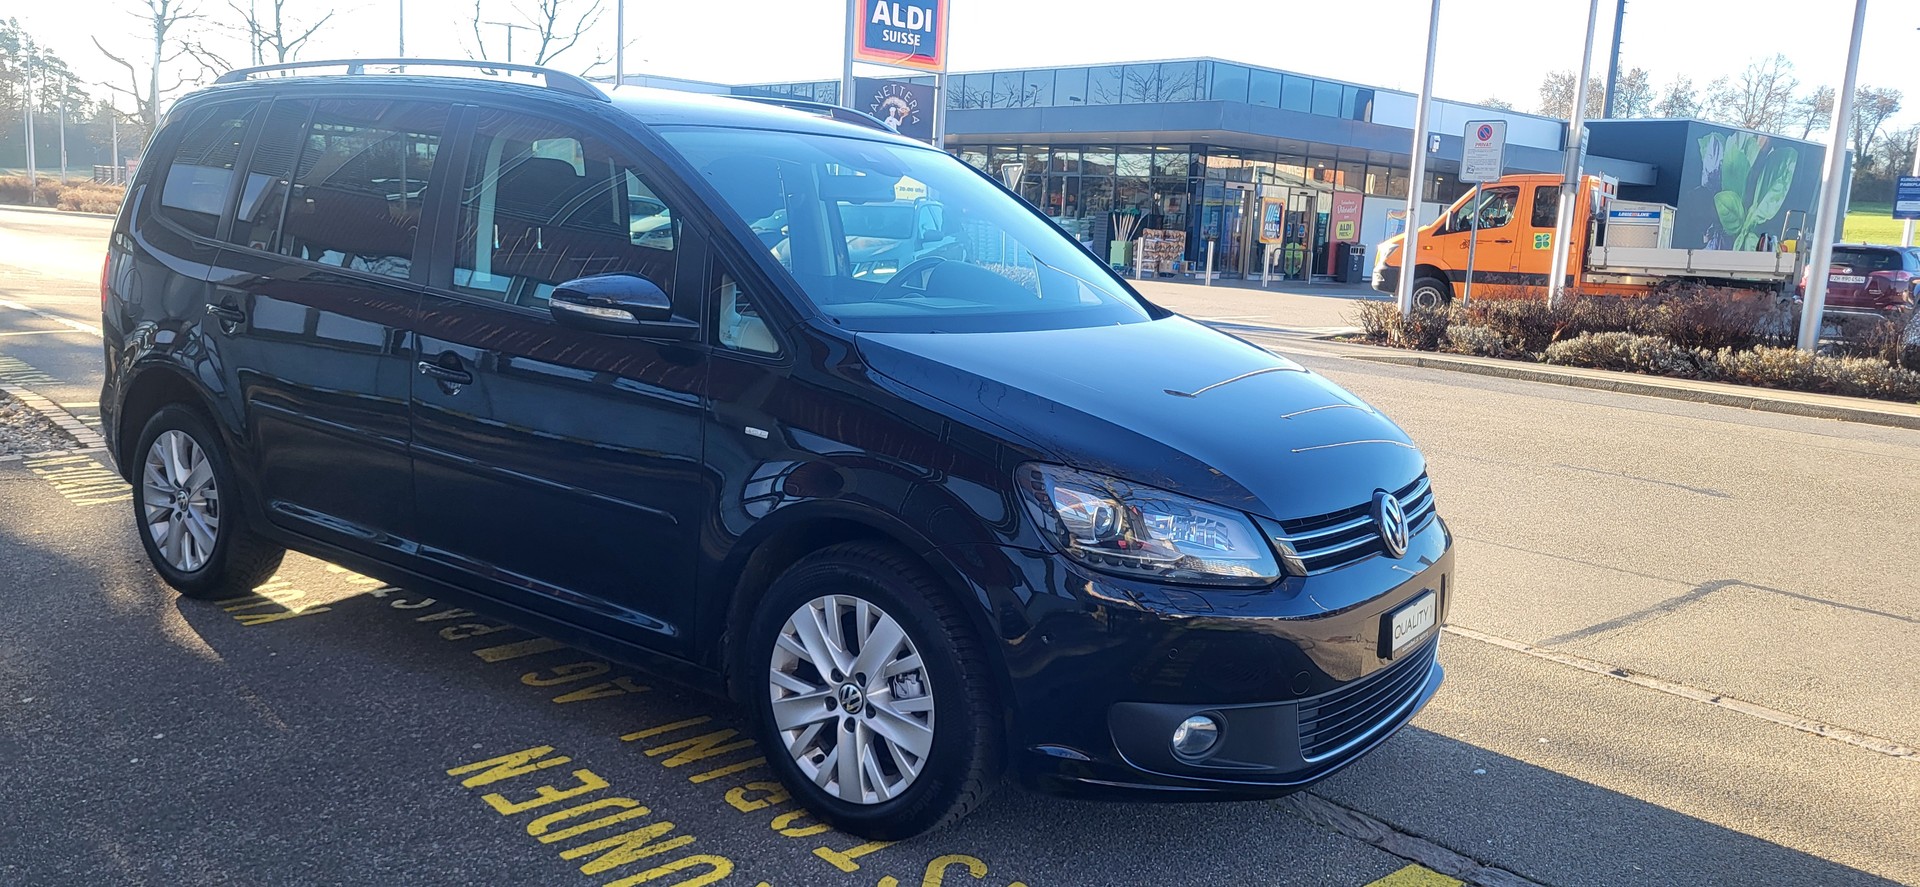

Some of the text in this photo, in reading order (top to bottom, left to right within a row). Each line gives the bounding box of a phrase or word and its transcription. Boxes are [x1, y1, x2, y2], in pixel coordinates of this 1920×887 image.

[871, 0, 933, 33] ALDI
[882, 29, 921, 47] SUISSE
[1394, 606, 1429, 640] QUALITY
[447, 745, 771, 887] UNDEN
